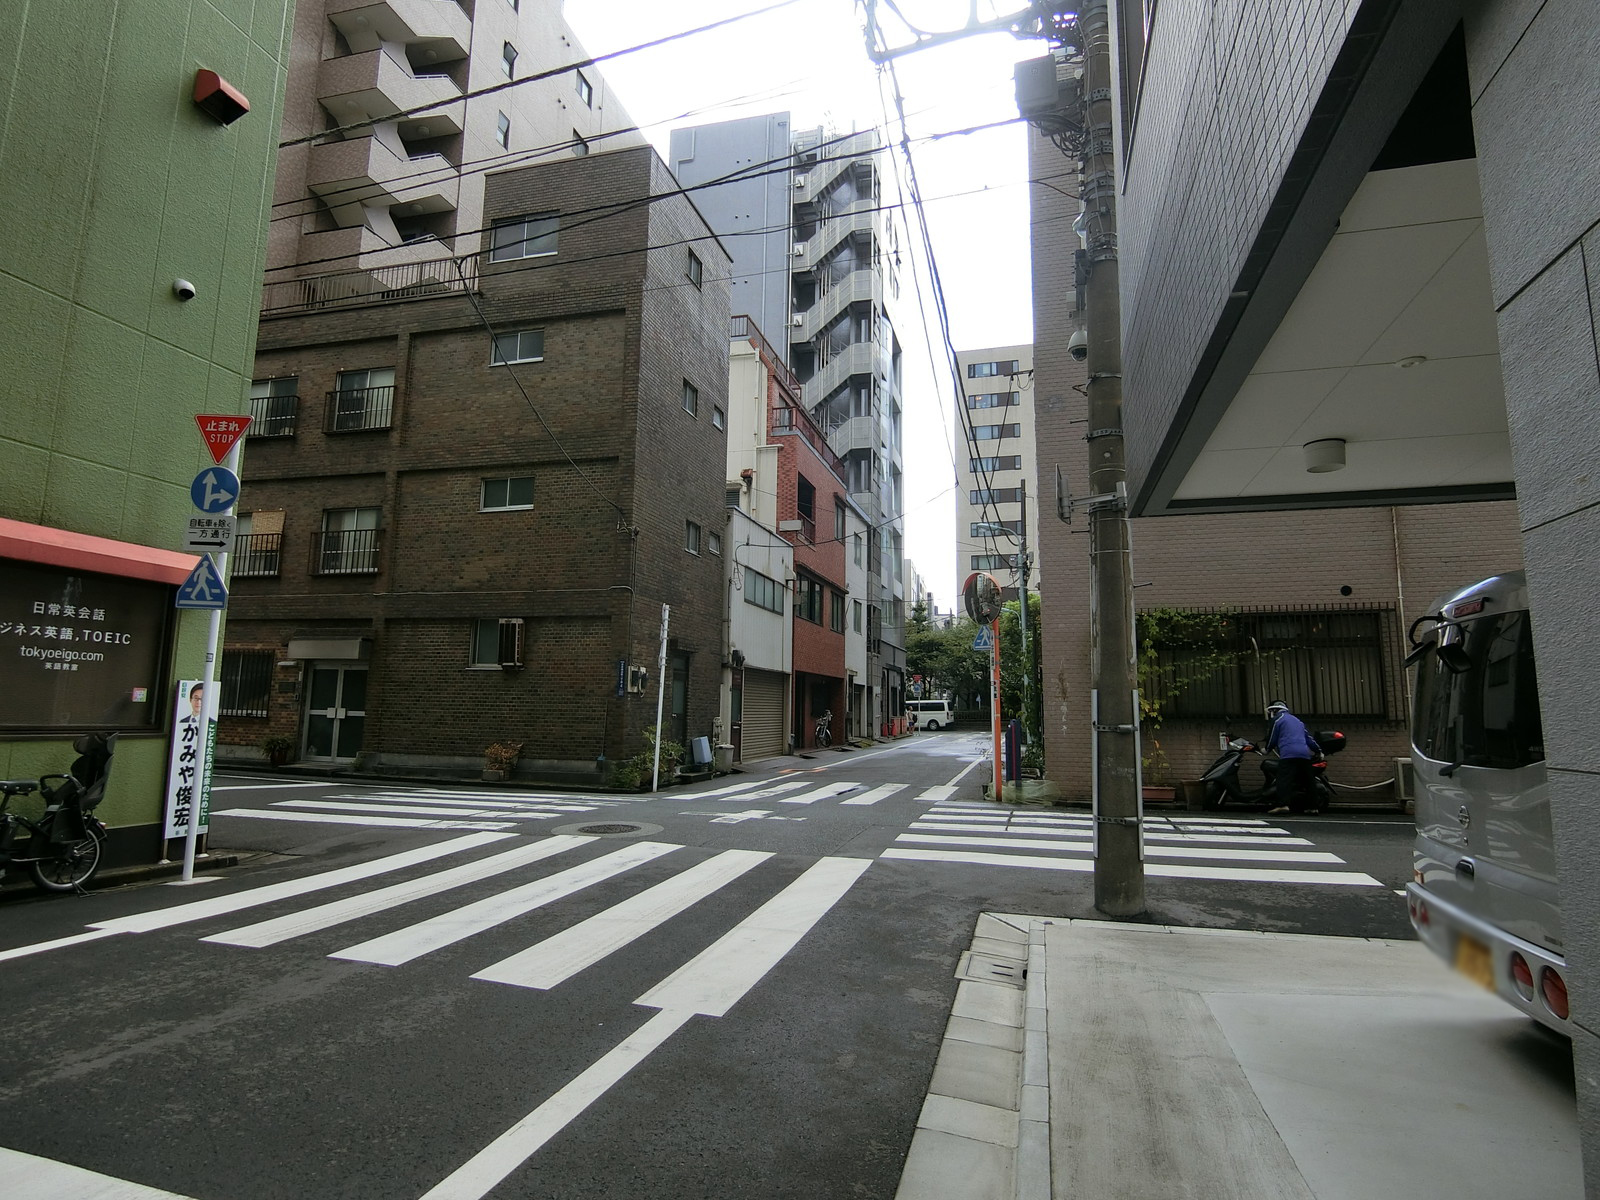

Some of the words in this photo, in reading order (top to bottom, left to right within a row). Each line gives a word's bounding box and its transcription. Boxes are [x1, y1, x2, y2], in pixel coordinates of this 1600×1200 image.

[205, 420, 240, 432] 止まれ
[210, 433, 234, 443] STOP
[189, 518, 231, 528] 自転車を除く
[188, 529, 231, 539] 一方通行
[33, 601, 106, 621] 日常英会話
[20, 645, 104, 662] tokyoeigo.com
[44, 662, 79, 671] 英語教室
[173, 724, 198, 827] かみや俊宏
